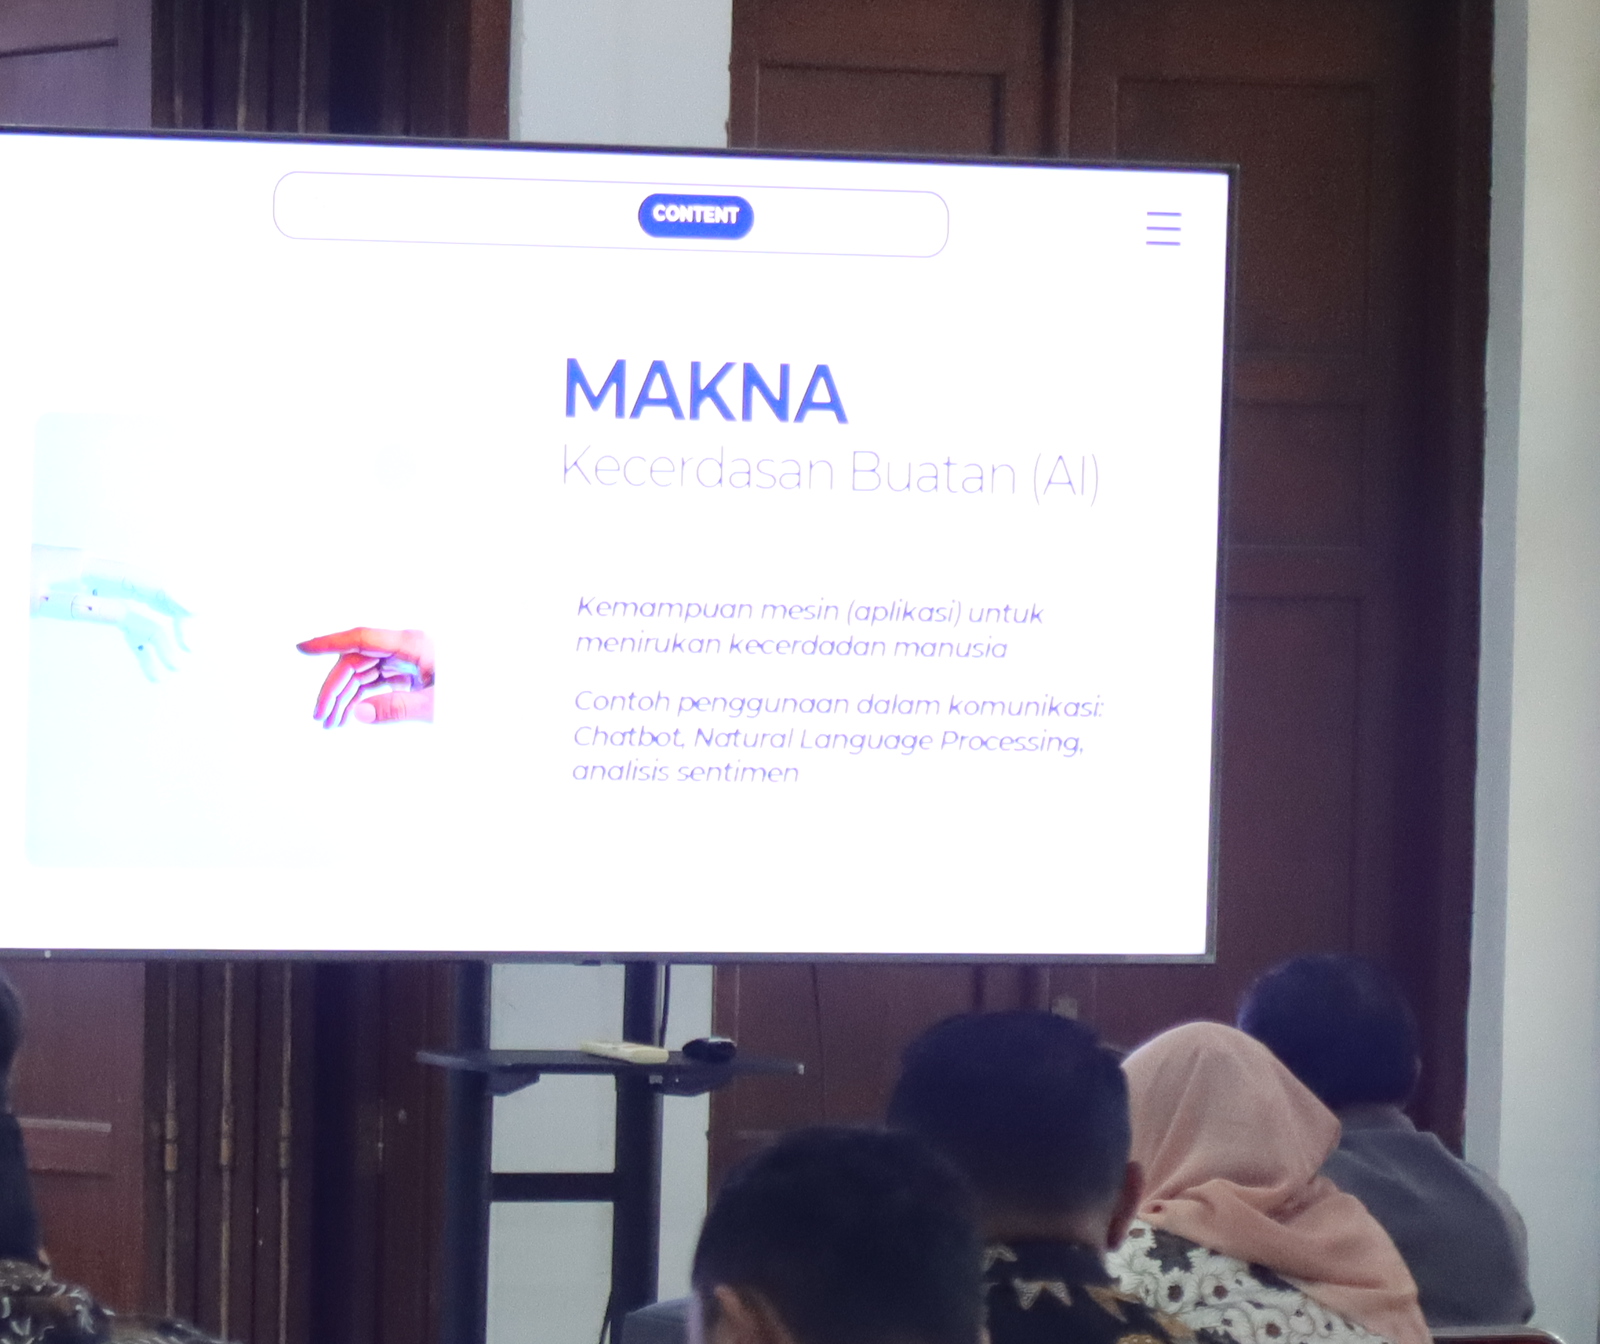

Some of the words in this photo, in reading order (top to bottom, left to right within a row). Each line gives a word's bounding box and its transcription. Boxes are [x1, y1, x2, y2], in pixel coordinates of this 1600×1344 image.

[653, 203, 741, 224] CONTENT
[565, 357, 849, 424] MAKNA
[563, 443, 834, 490] Kecerdasan
[851, 450, 1016, 495] Buatan
[1033, 453, 1099, 507] (AI)
[577, 596, 753, 623] Kemampuan
[761, 597, 839, 621] mesin
[847, 598, 962, 627] (aplikasi)
[968, 603, 1044, 624] untuk
[576, 629, 721, 654] menirukan
[729, 632, 886, 656] kecerdadan
[894, 635, 1008, 658] manusia
[574, 690, 670, 712] Contoh
[677, 696, 849, 723] penggunaan
[856, 693, 941, 716] dalam
[948, 693, 1104, 718] komunikasi:
[574, 725, 685, 750] Chatbot,
[694, 727, 794, 749] Natural
[800, 729, 934, 756] Language
[940, 730, 1084, 759] Processing,
[572, 758, 669, 782] analisis
[677, 760, 799, 784] sentimen
